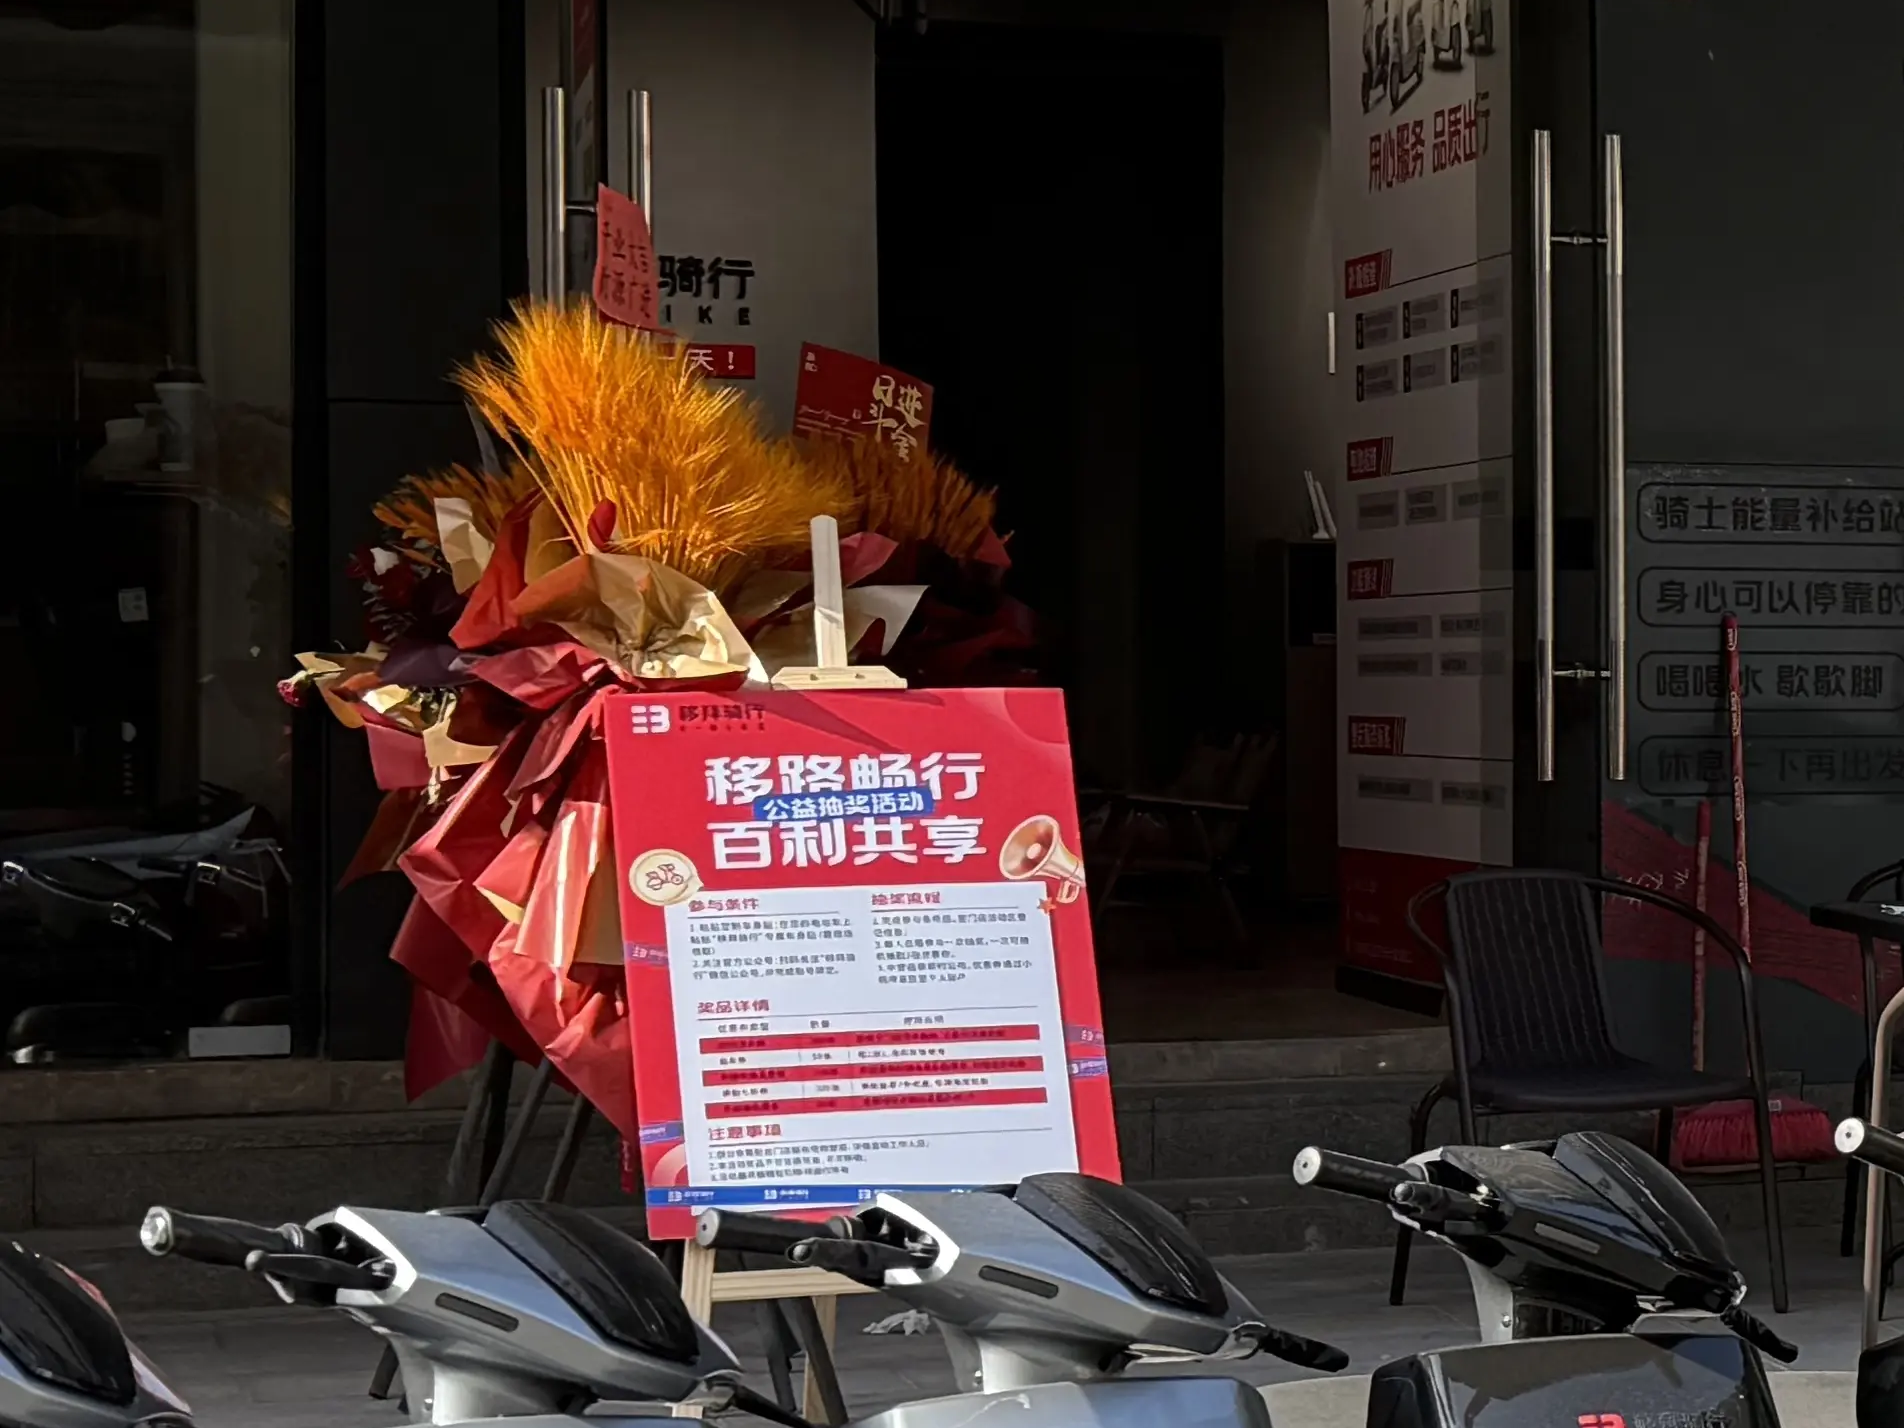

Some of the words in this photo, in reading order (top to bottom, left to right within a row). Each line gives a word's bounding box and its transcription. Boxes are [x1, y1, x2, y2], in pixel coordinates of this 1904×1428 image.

[1369, 120, 1425, 194] 用心服务
[1433, 91, 1490, 173] 品质出行
[658, 256, 754, 298] 骑行
[1777, 664, 1883, 698] 歇歇脚
[705, 752, 985, 805] 移路畅行
[763, 793, 924, 820] 公益抽奖活动
[707, 816, 987, 870] 百利共享
